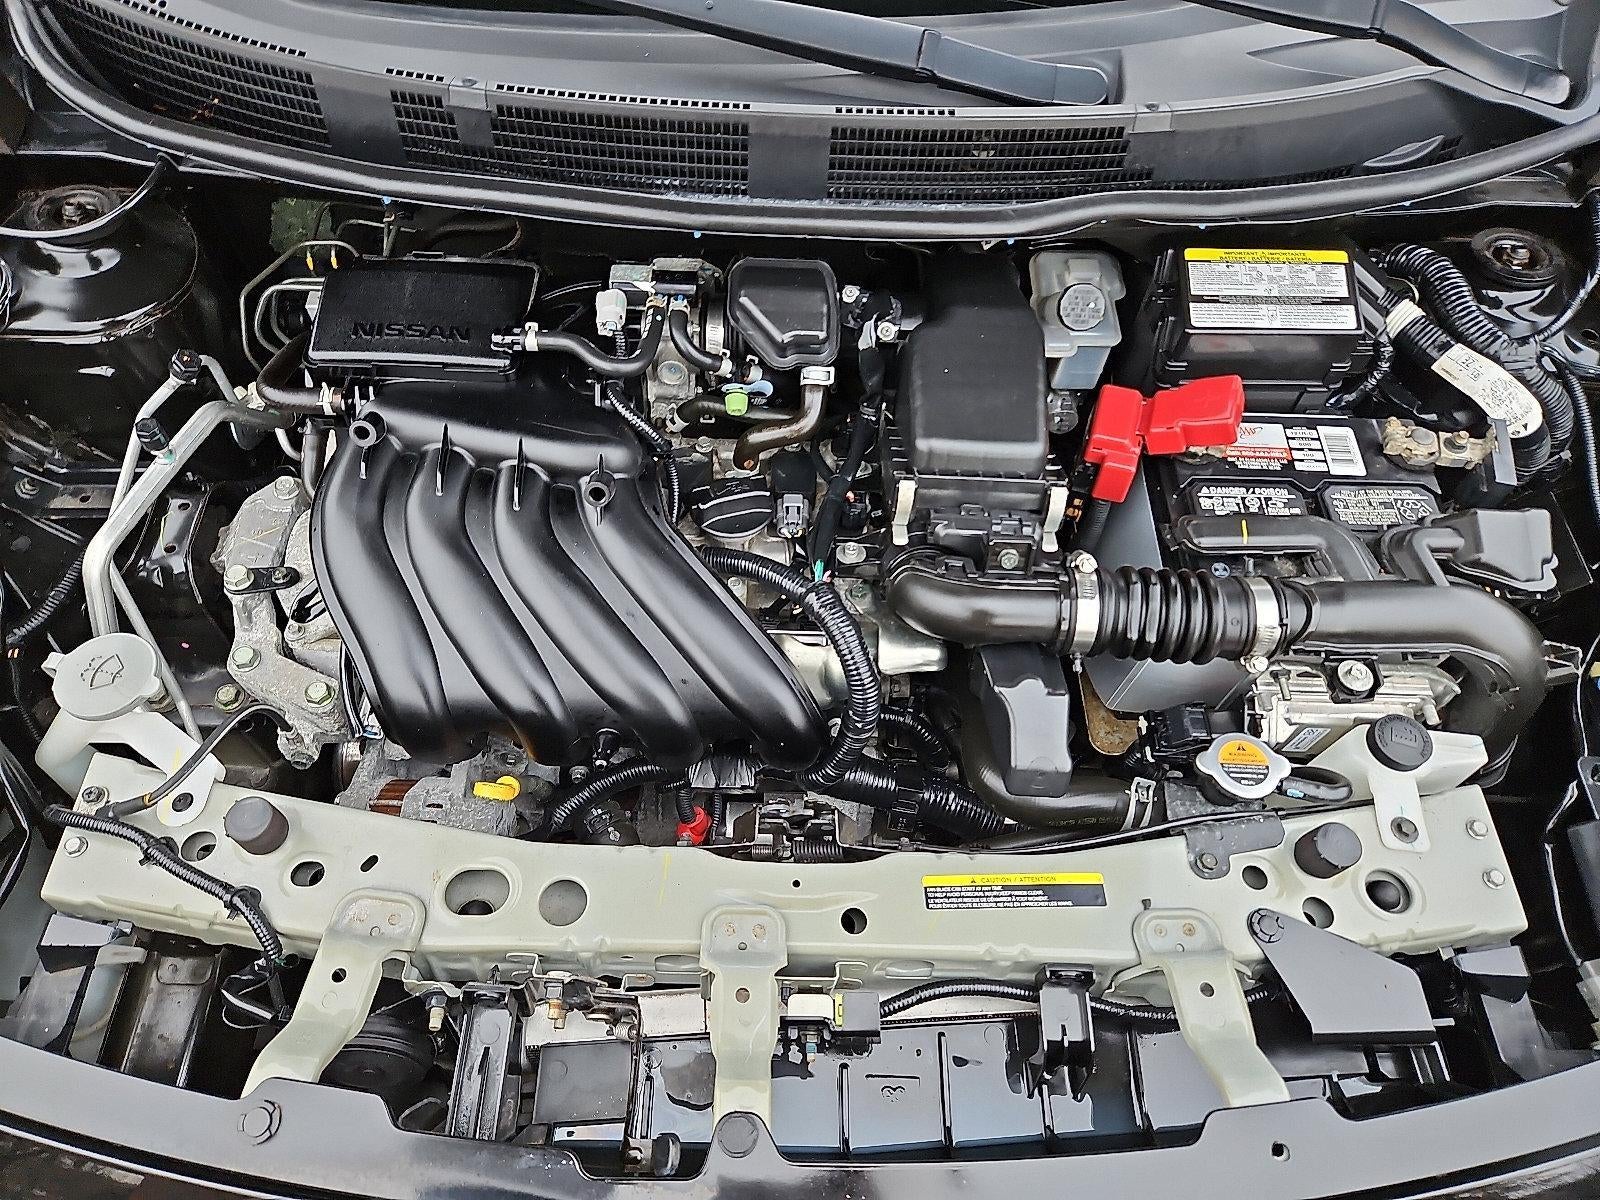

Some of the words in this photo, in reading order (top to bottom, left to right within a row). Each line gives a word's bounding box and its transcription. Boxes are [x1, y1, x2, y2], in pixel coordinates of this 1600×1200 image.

[351, 322, 470, 343] NISSAN
[1210, 487, 1247, 495] DANGER
[1255, 487, 1289, 496] POISON
